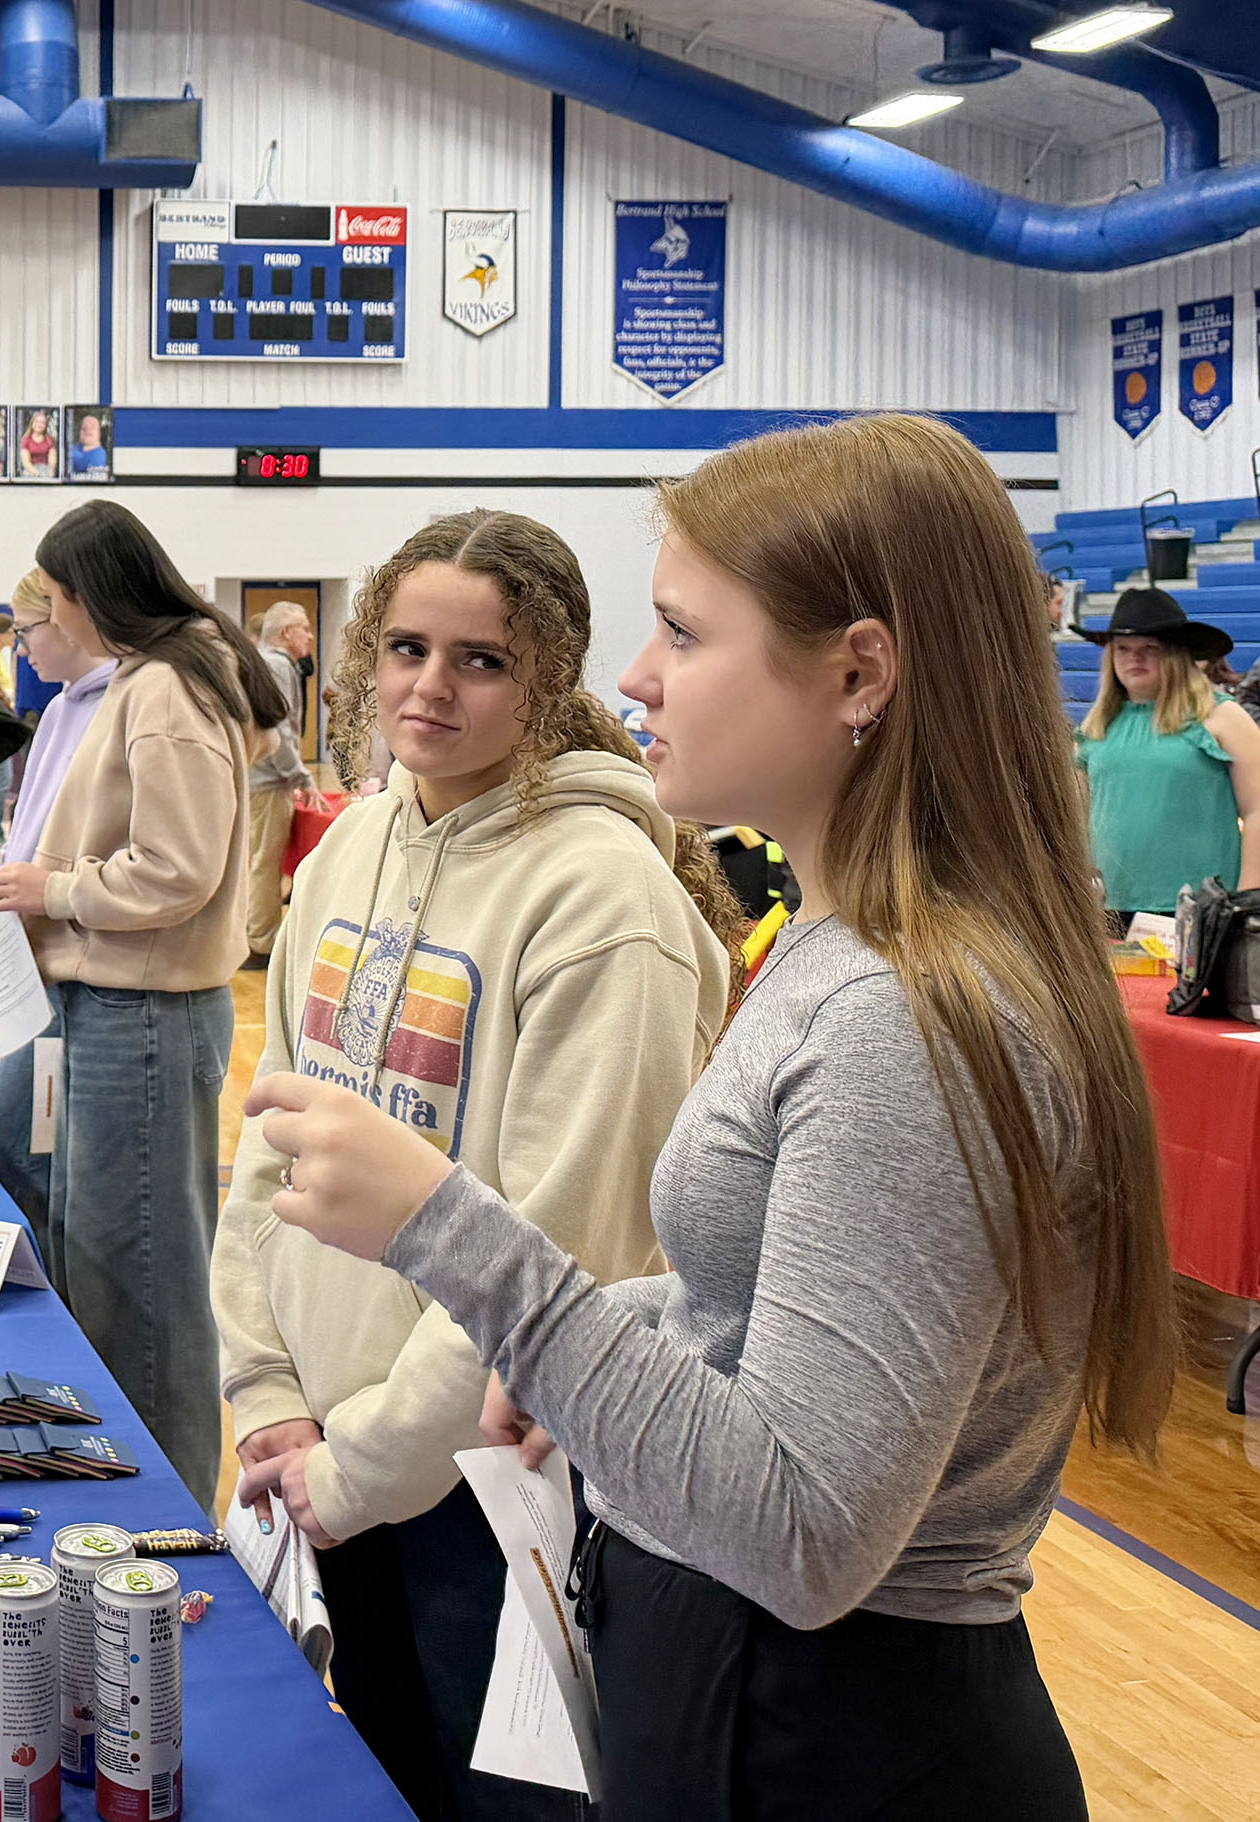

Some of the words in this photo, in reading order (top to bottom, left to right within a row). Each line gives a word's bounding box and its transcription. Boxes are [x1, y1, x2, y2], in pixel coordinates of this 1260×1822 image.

[616, 203, 662, 216] Bertrand
[664, 203, 689, 219] High
[692, 204, 725, 217] School
[348, 215, 402, 237] Coca-Cola
[175, 244, 219, 260] HOME
[342, 246, 392, 264] GUEST
[264, 253, 301, 267] PERIOD
[166, 299, 200, 313] FOULS
[246, 301, 285, 313] PLAYER
[290, 301, 316, 314] FOUL
[361, 302, 396, 316] FOULS
[449, 301, 510, 323] VIKINGS
[166, 343, 200, 355] SCORE
[263, 344, 300, 356] MATCH
[362, 345, 396, 357] SCORE
[363, 979, 388, 1000] FFA
[389, 1083, 438, 1129] ffa
[147, 1538, 198, 1551] HEATH
[108, 1605, 129, 1618] Facts
